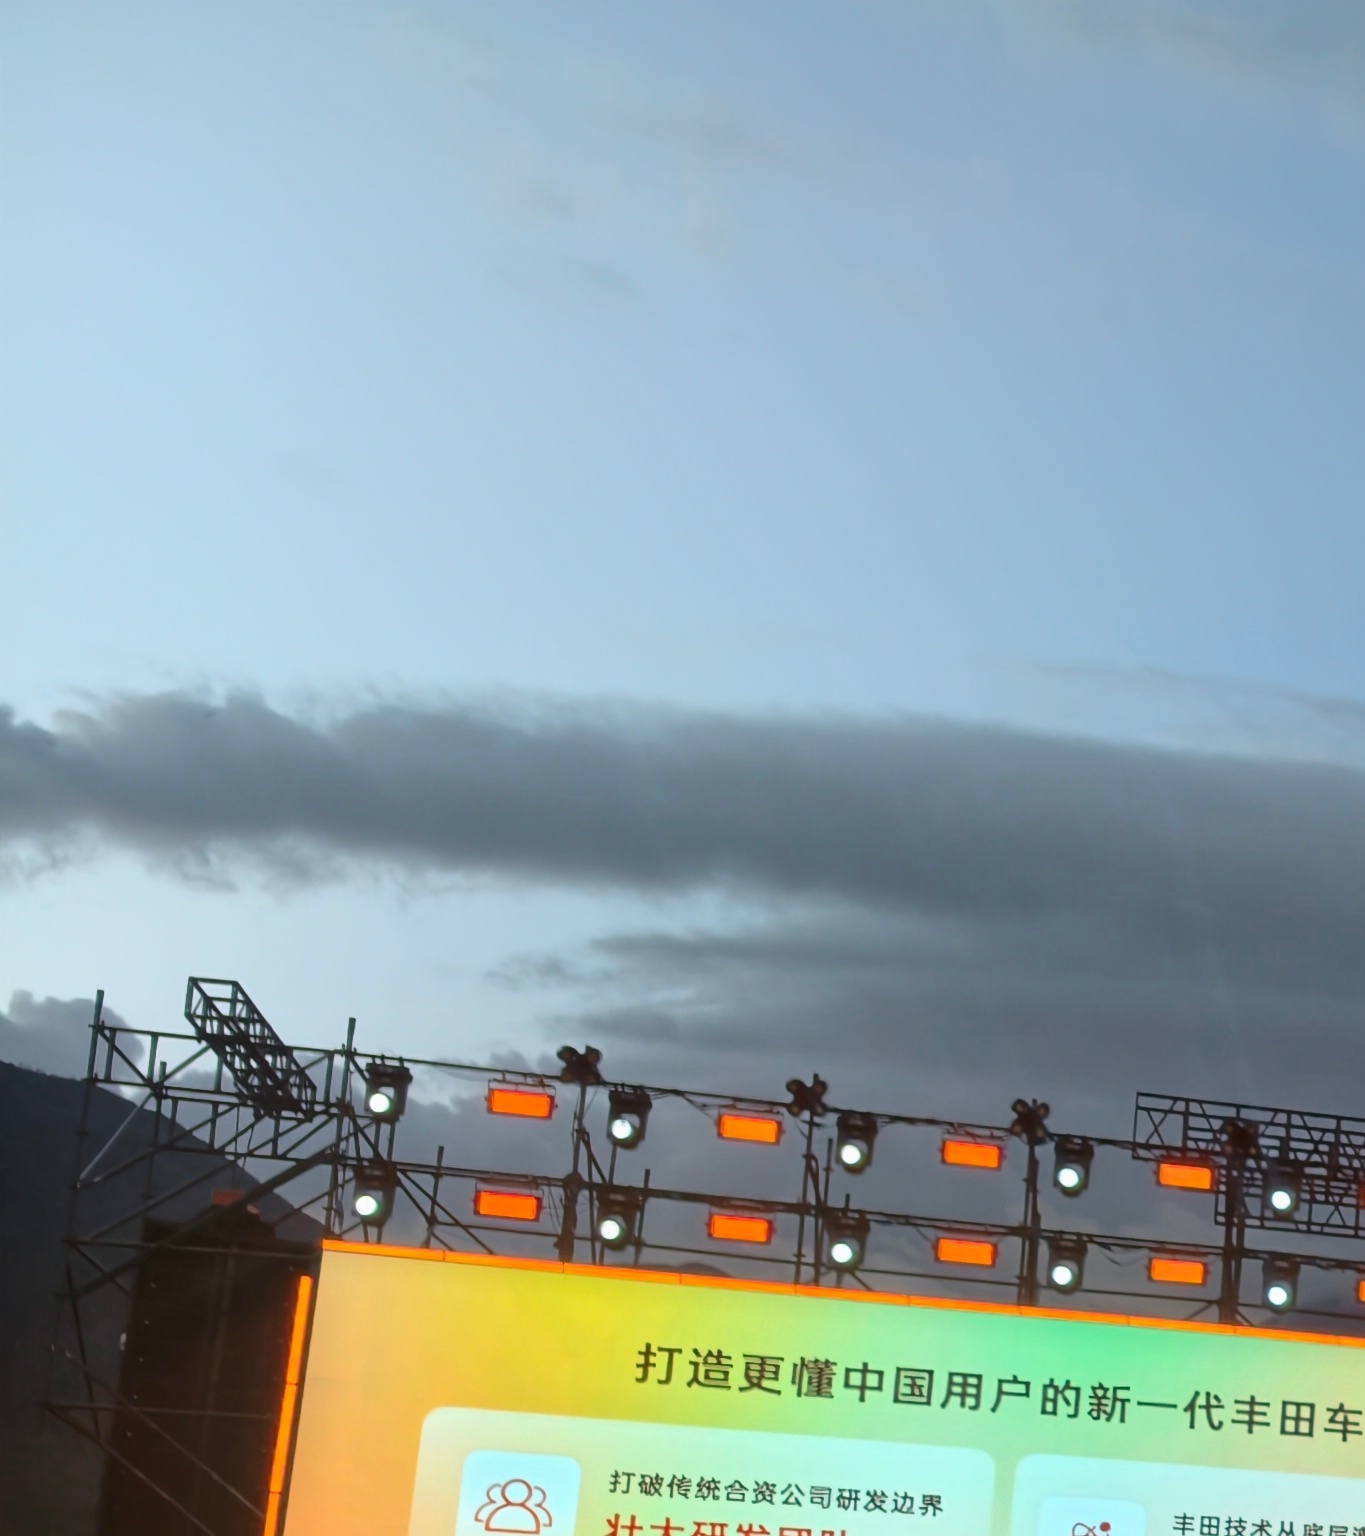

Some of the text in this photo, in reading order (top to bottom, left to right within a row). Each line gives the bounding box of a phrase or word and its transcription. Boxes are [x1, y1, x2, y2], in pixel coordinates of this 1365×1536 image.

[635, 1341, 1365, 1443] 打造更懂中国用户的新一代丰田车
[608, 1468, 944, 1517] 打破传统合资公司研发边界
